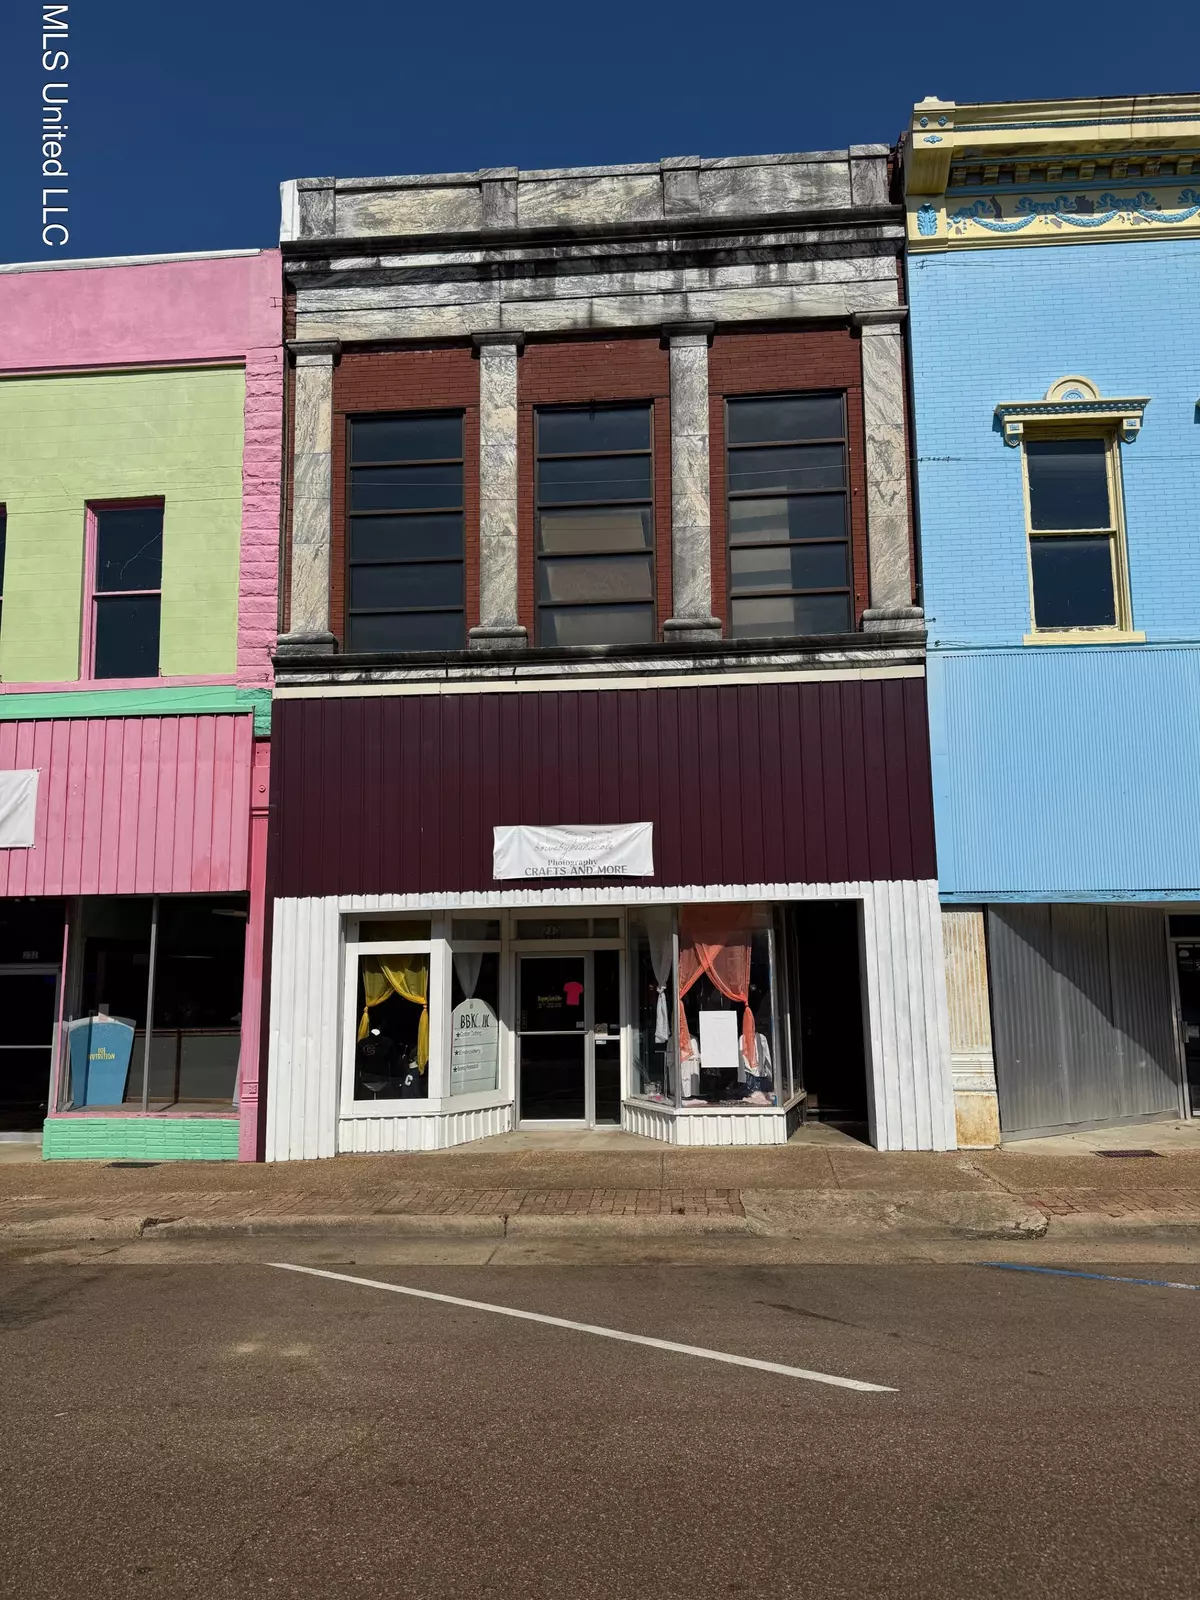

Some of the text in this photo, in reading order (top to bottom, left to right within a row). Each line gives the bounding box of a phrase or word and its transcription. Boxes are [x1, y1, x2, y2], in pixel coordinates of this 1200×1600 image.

[547, 858, 598, 868] Photography
[524, 865, 628, 876] CRAFTS AND MORE
[88, 1052, 116, 1061] NUTRITION
